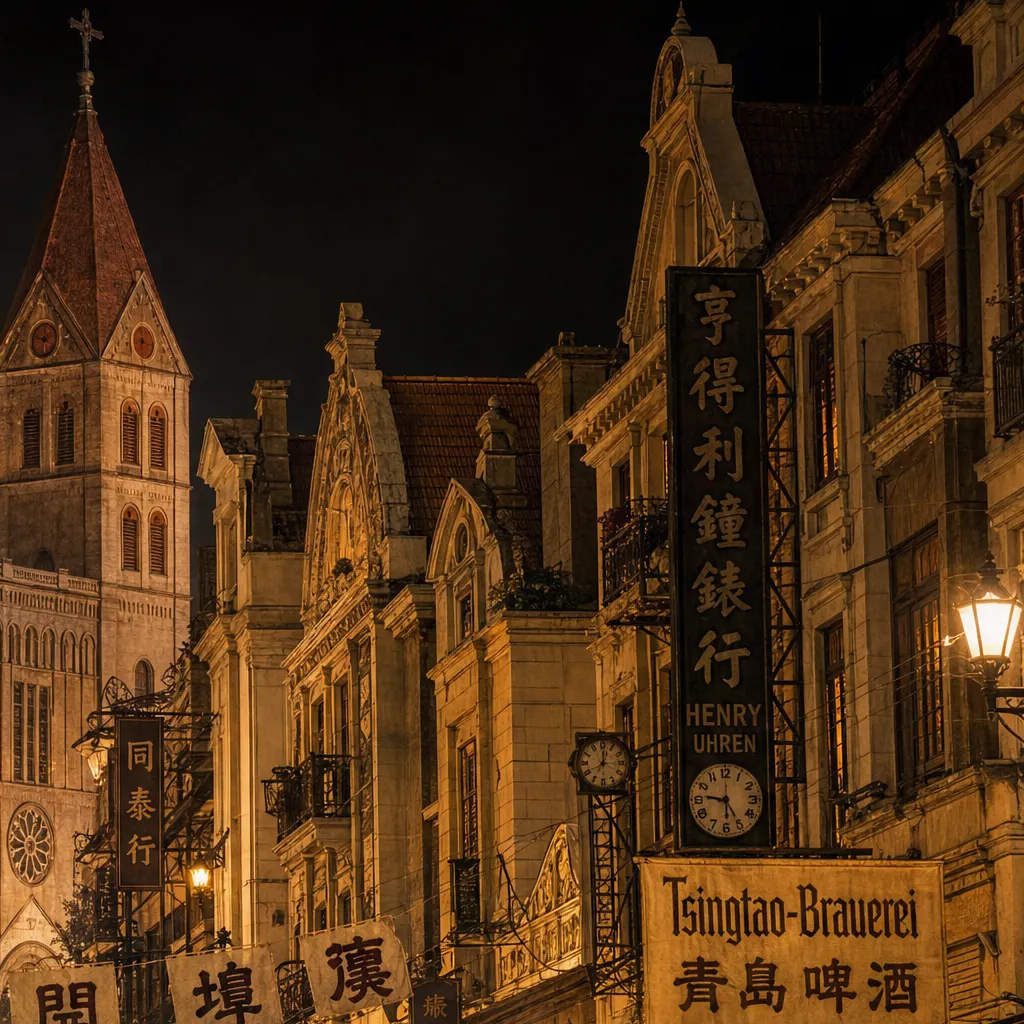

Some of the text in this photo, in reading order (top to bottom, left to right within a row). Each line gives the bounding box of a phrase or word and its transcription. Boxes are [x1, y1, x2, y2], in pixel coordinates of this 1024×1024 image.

[686, 703, 761, 726] HENRY
[693, 733, 756, 753] UHREN
[126, 740, 156, 866] 同泰行
[663, 875, 919, 946] Tsingtao-Brauerei
[673, 956, 918, 1014] 青島啤酒
